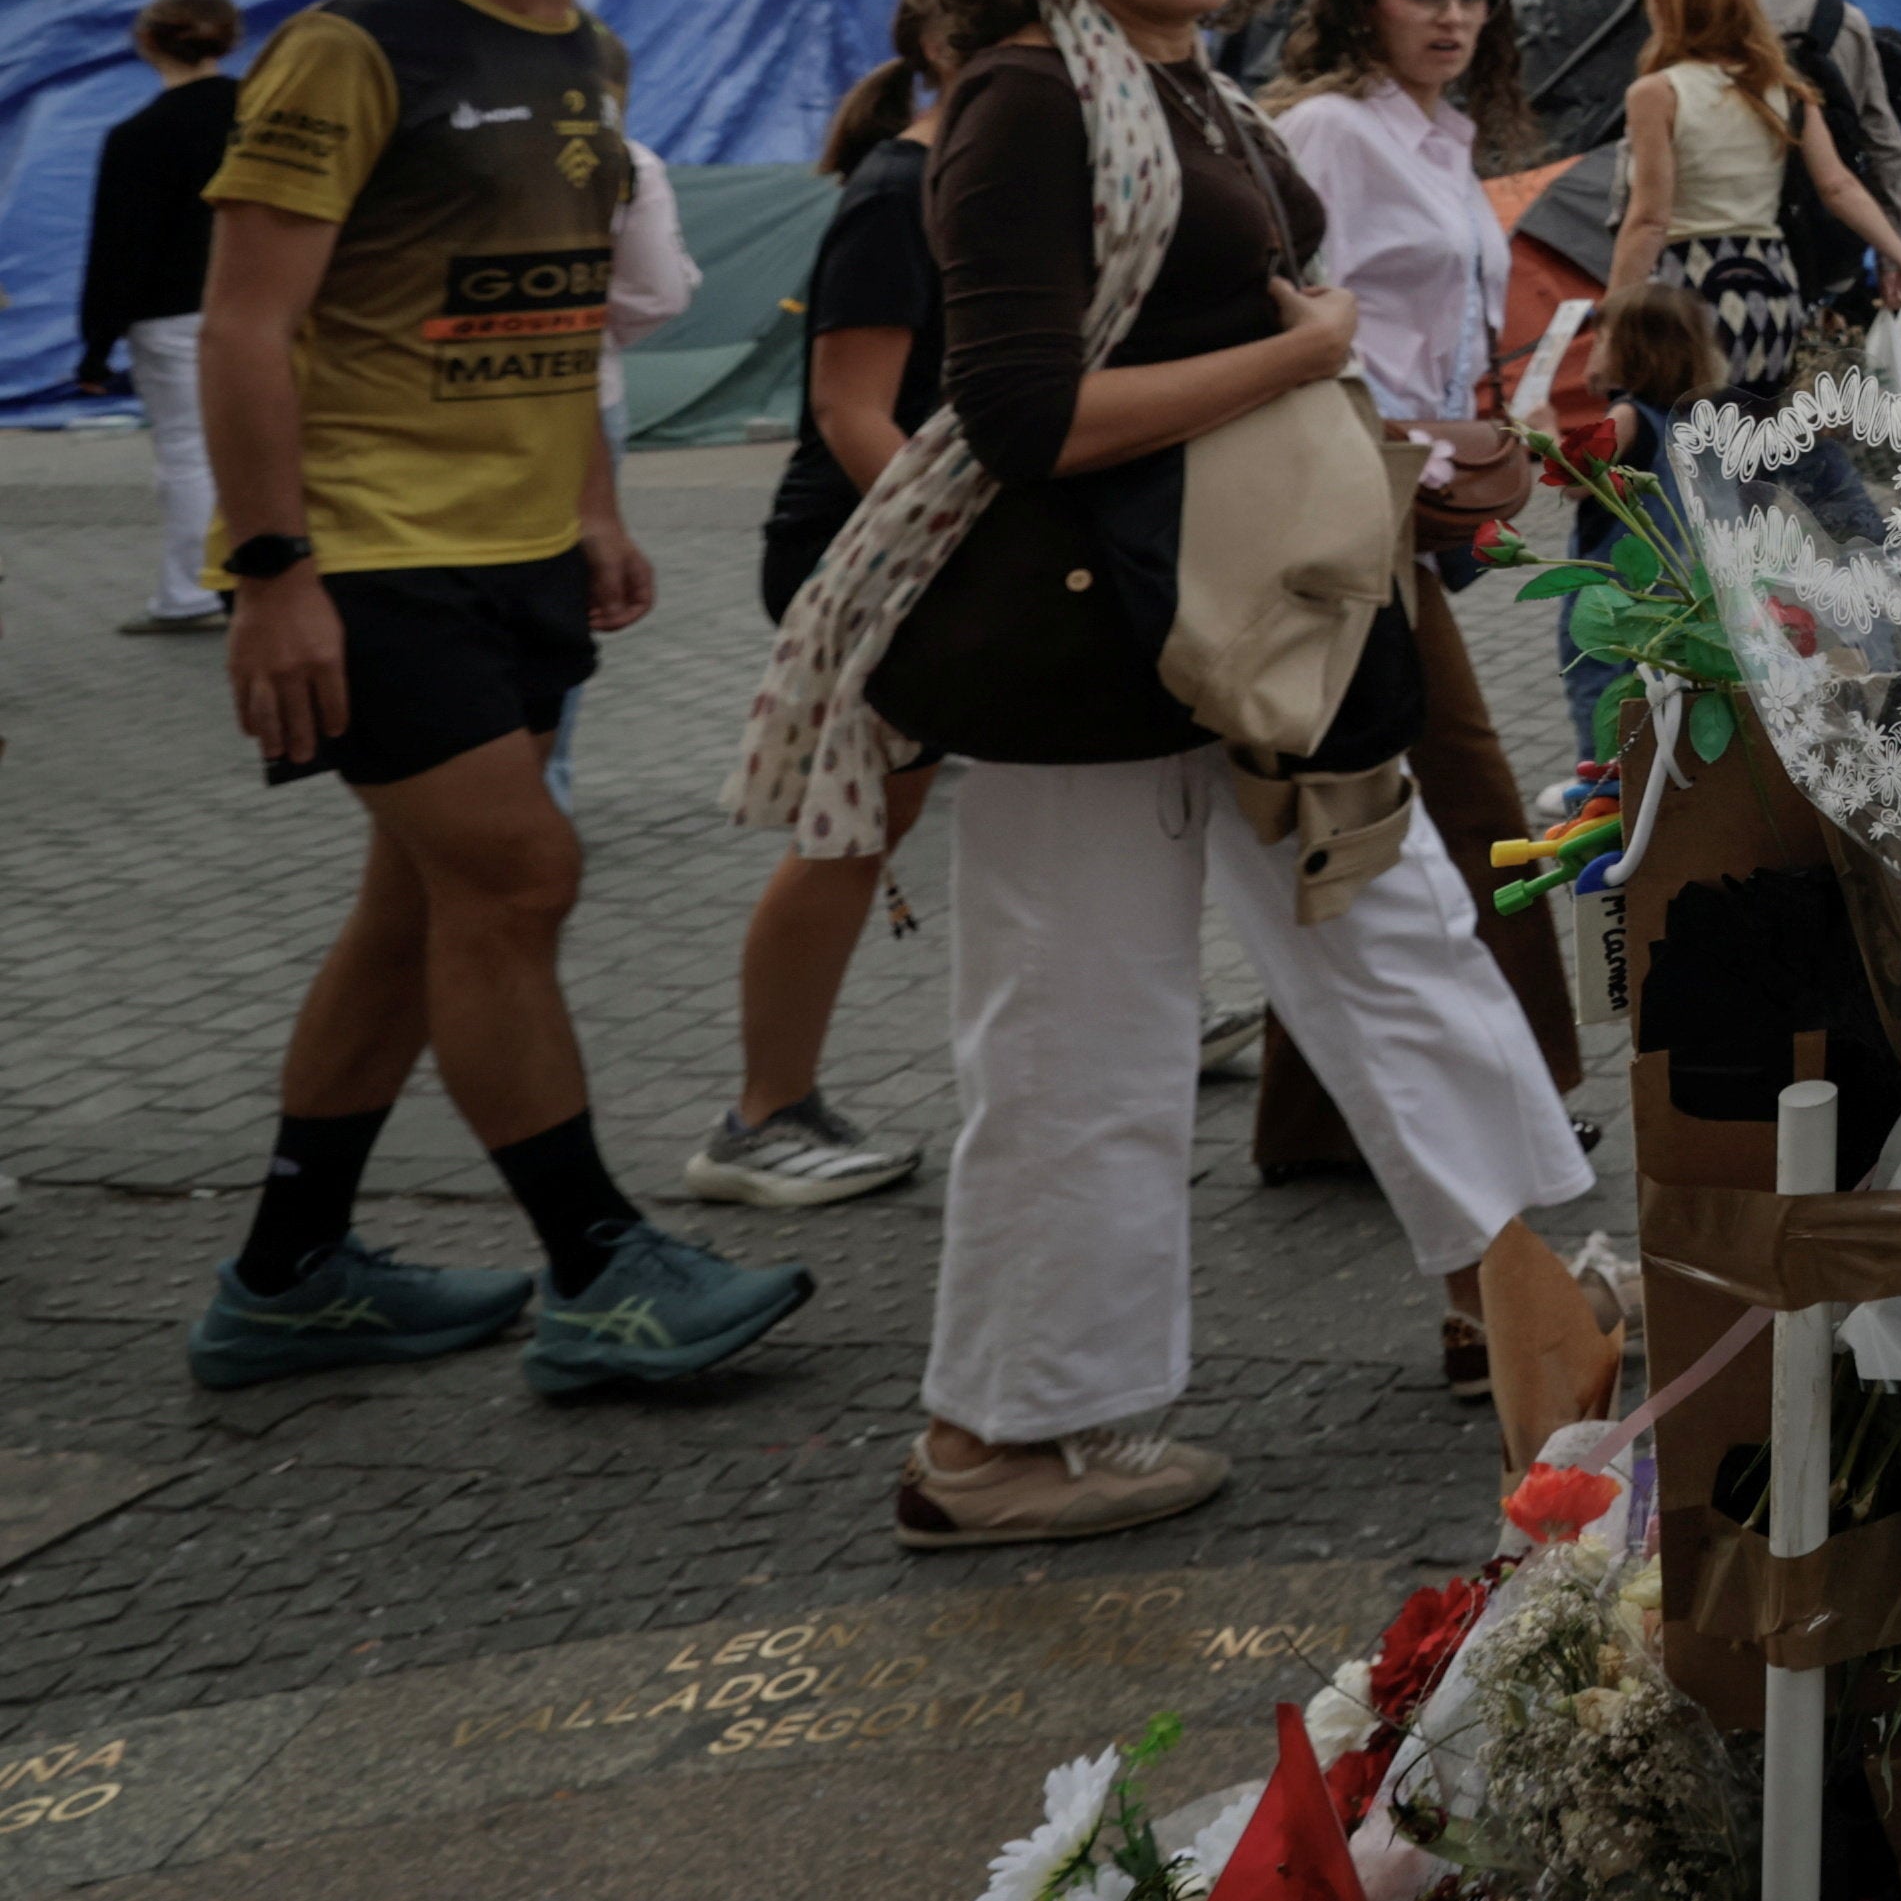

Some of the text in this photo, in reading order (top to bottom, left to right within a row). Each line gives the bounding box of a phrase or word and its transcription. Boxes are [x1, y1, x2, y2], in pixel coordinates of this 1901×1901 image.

[664, 1612, 870, 1673] LEÓN
[451, 1655, 930, 1748] VALLADOLID
[707, 1690, 1028, 1755] SEGOVIA
